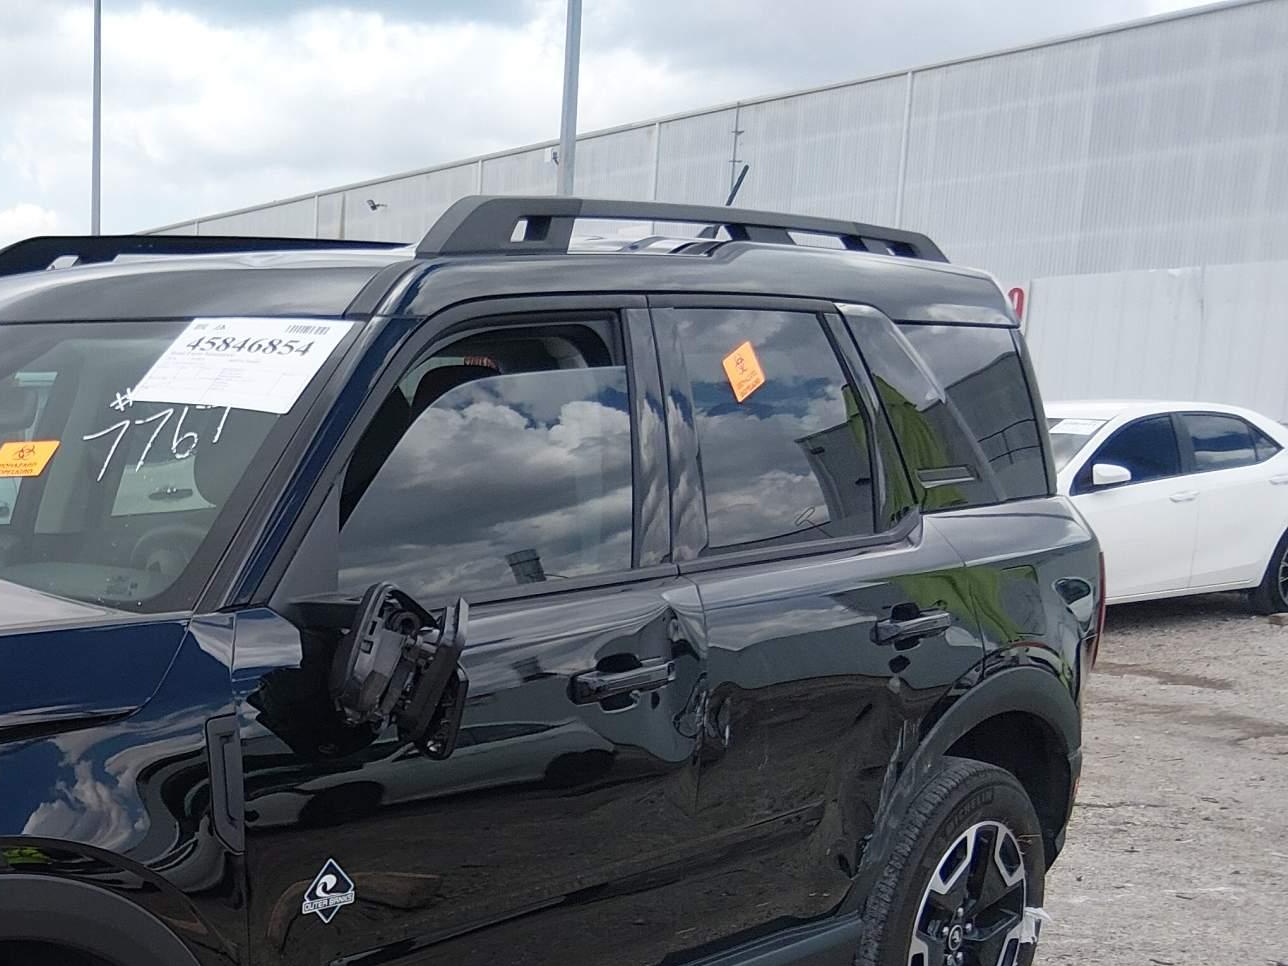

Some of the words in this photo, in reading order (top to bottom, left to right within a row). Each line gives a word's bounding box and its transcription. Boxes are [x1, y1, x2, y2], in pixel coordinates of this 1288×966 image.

[186, 335, 315, 357] 45846854
[304, 900, 328, 911] OUTER
[330, 894, 353, 905] BANKS
